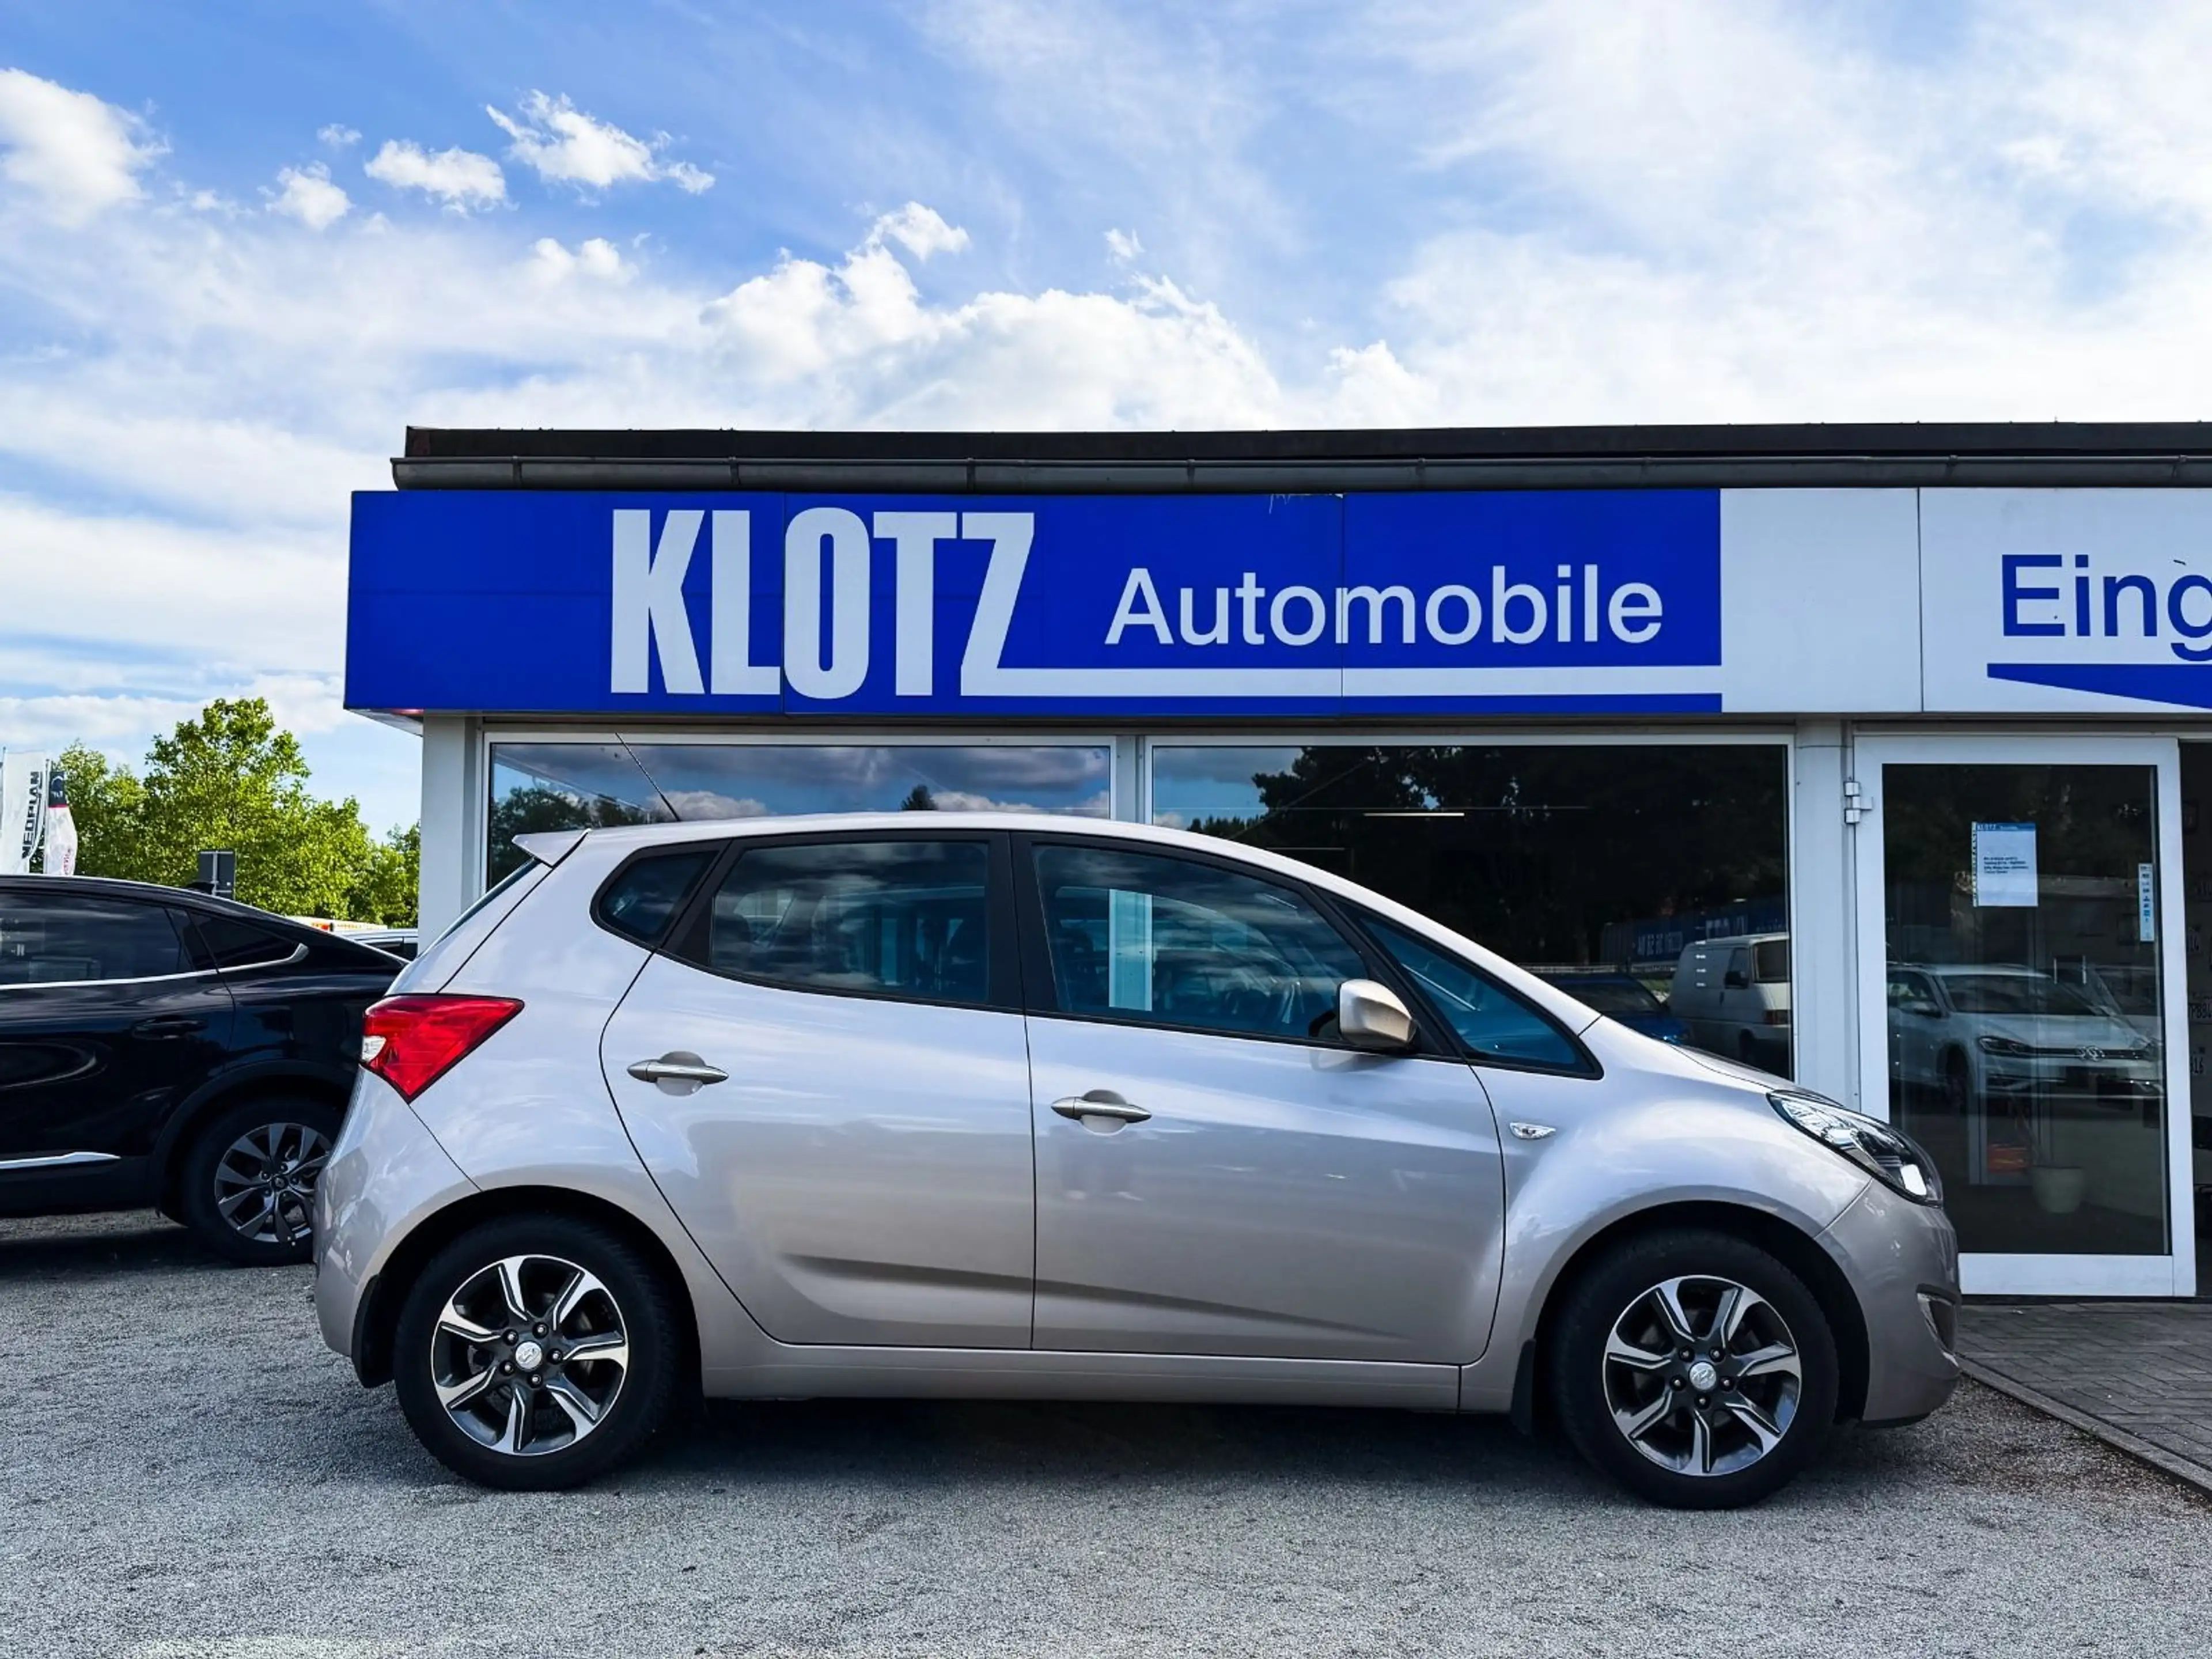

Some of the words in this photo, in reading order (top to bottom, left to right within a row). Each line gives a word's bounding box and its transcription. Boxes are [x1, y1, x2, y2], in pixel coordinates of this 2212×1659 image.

[611, 507, 1035, 699] KLOTZ
[1104, 563, 1664, 646] Automobile
[21, 771, 40, 859] NEOPLAN
